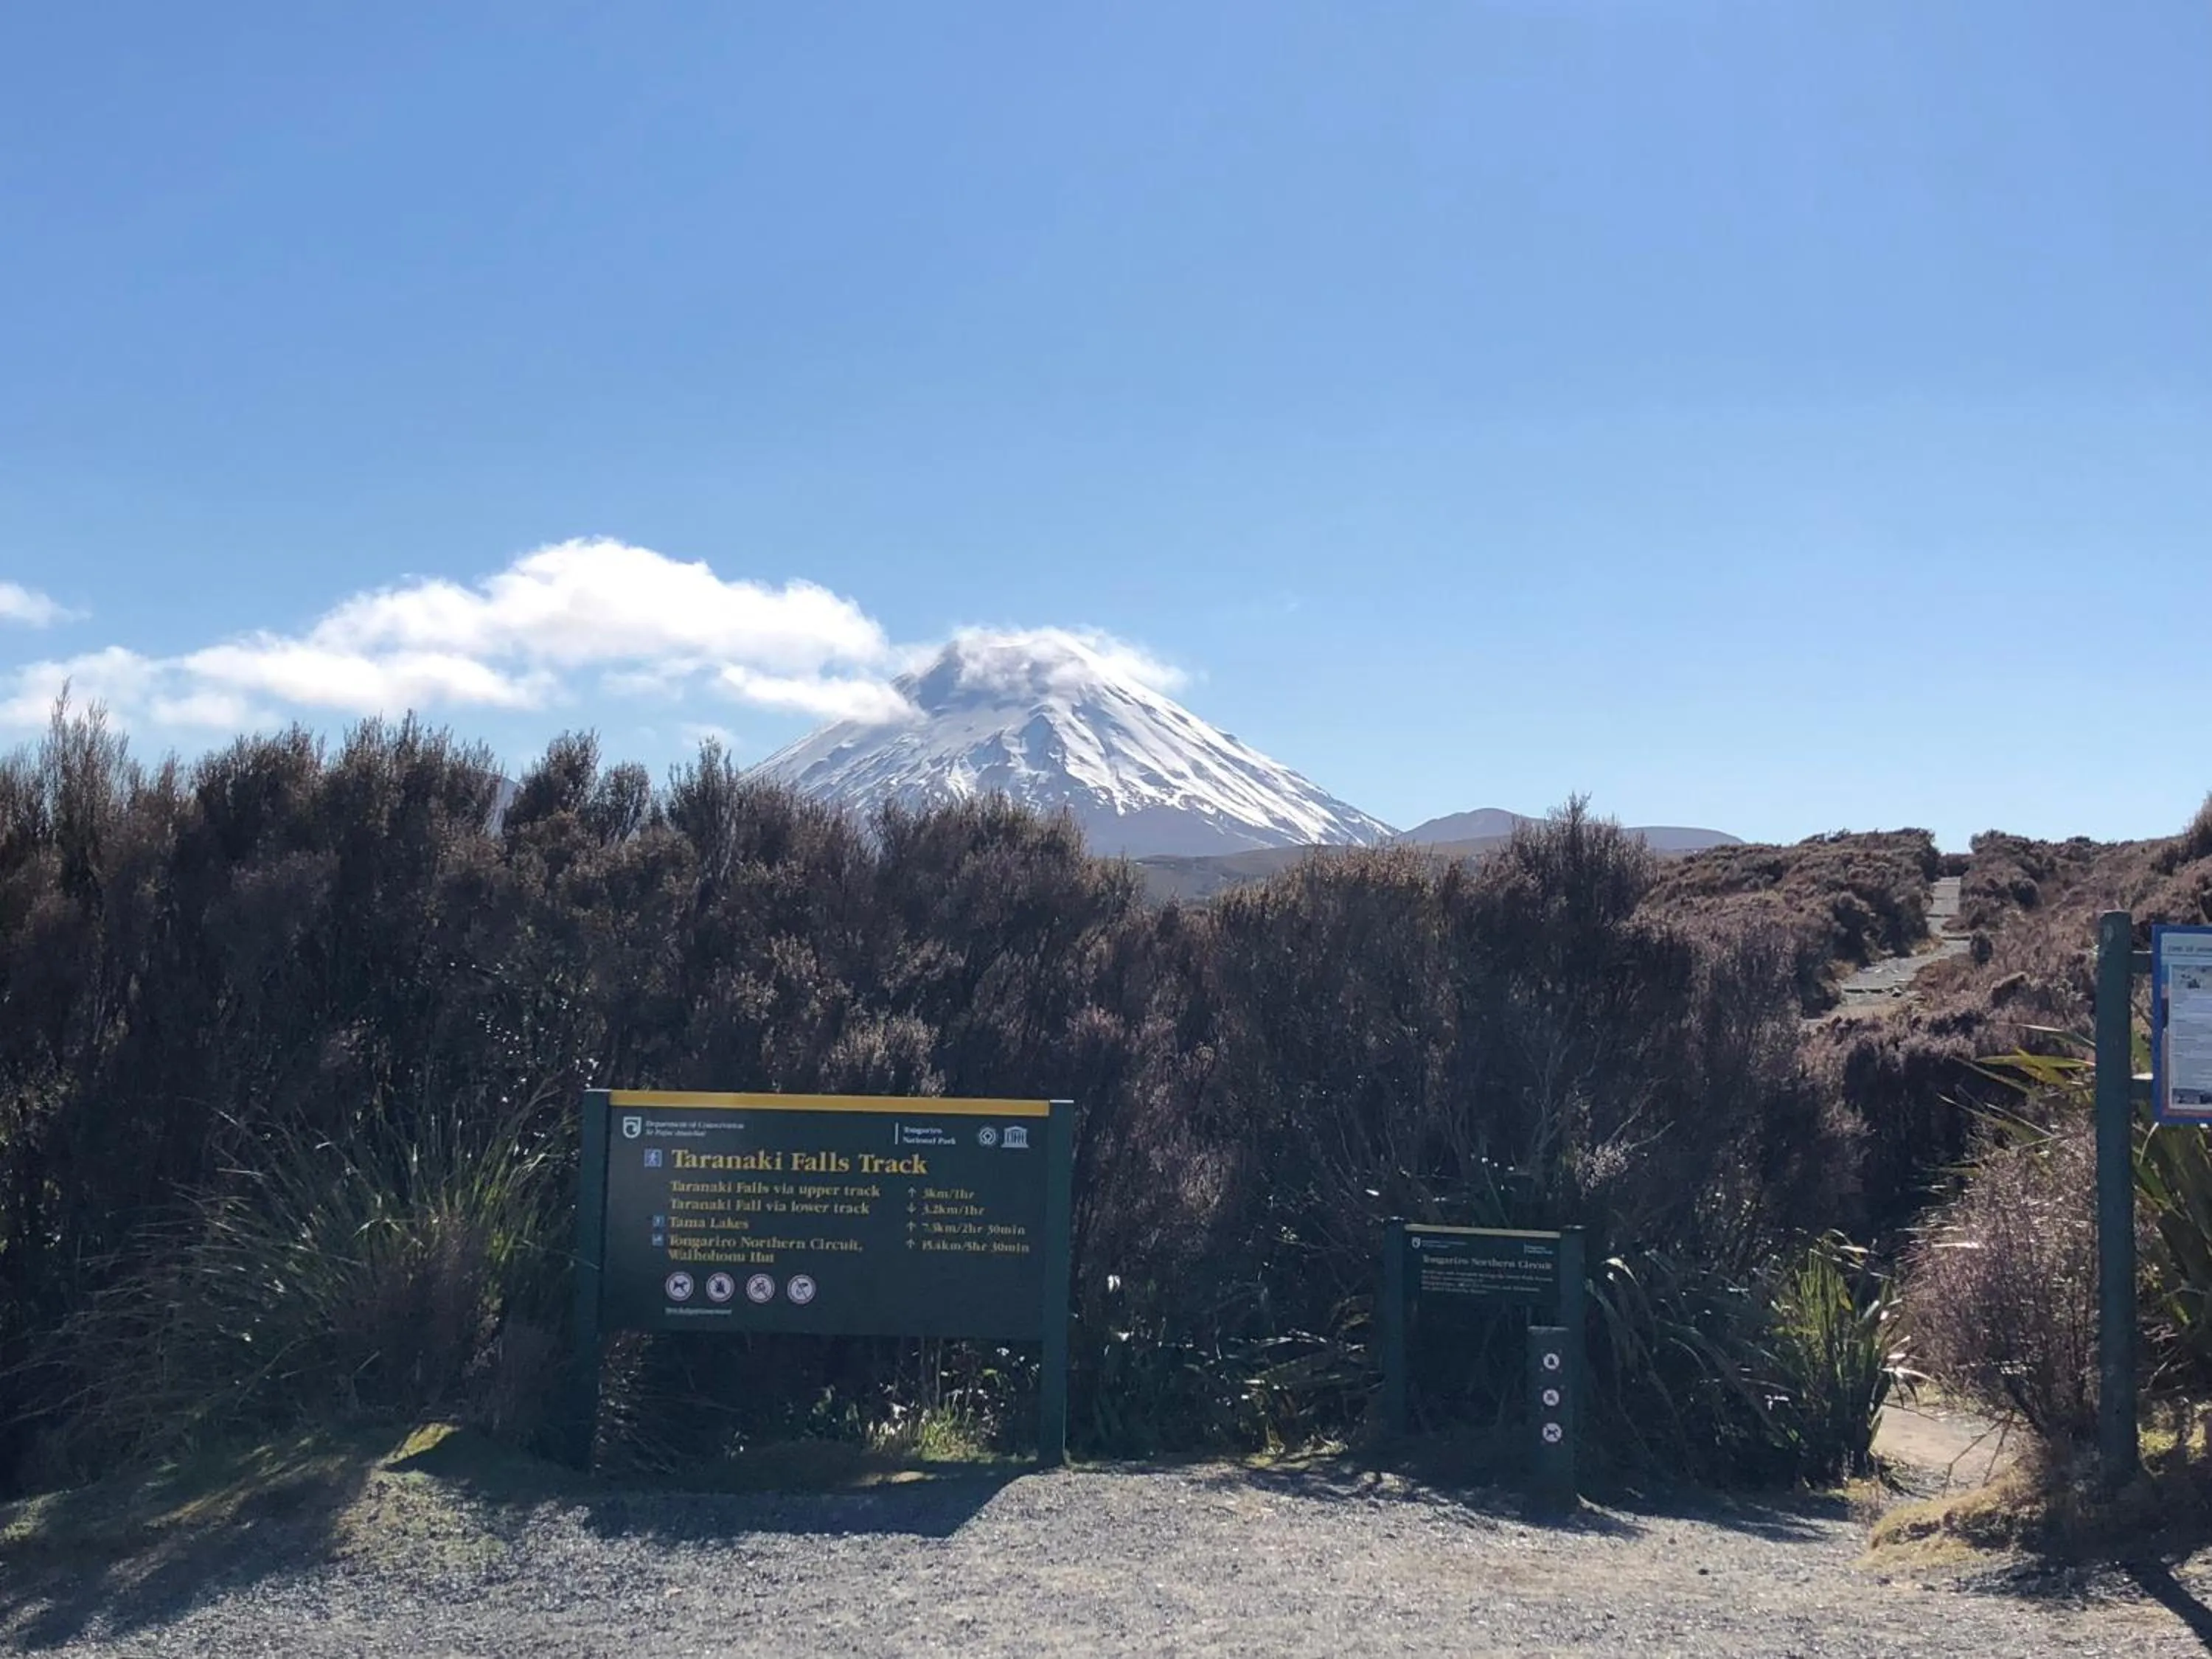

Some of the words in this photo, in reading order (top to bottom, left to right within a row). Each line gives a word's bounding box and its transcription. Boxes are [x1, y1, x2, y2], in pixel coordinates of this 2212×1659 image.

[903, 1136, 936, 1145] National
[937, 1137, 956, 1145] Park
[672, 1149, 782, 1171] Taranaki
[790, 1151, 850, 1172] Falls
[858, 1153, 928, 1175] Track
[669, 1180, 732, 1193] Taranaki
[737, 1181, 770, 1194] Falls
[774, 1183, 794, 1194] via
[799, 1185, 841, 1198] upper
[844, 1185, 880, 1197] track
[669, 1198, 732, 1211] Taranaki
[736, 1199, 762, 1211] Fall
[766, 1200, 787, 1211] via
[791, 1200, 830, 1213] lower
[834, 1201, 870, 1214] track
[669, 1217, 706, 1228] Tama
[710, 1217, 750, 1230] Lakes
[669, 1233, 737, 1248] Tongariro
[740, 1235, 806, 1250] Northern
[749, 1251, 774, 1263] Hut
[1471, 1256, 1516, 1268] Northern
